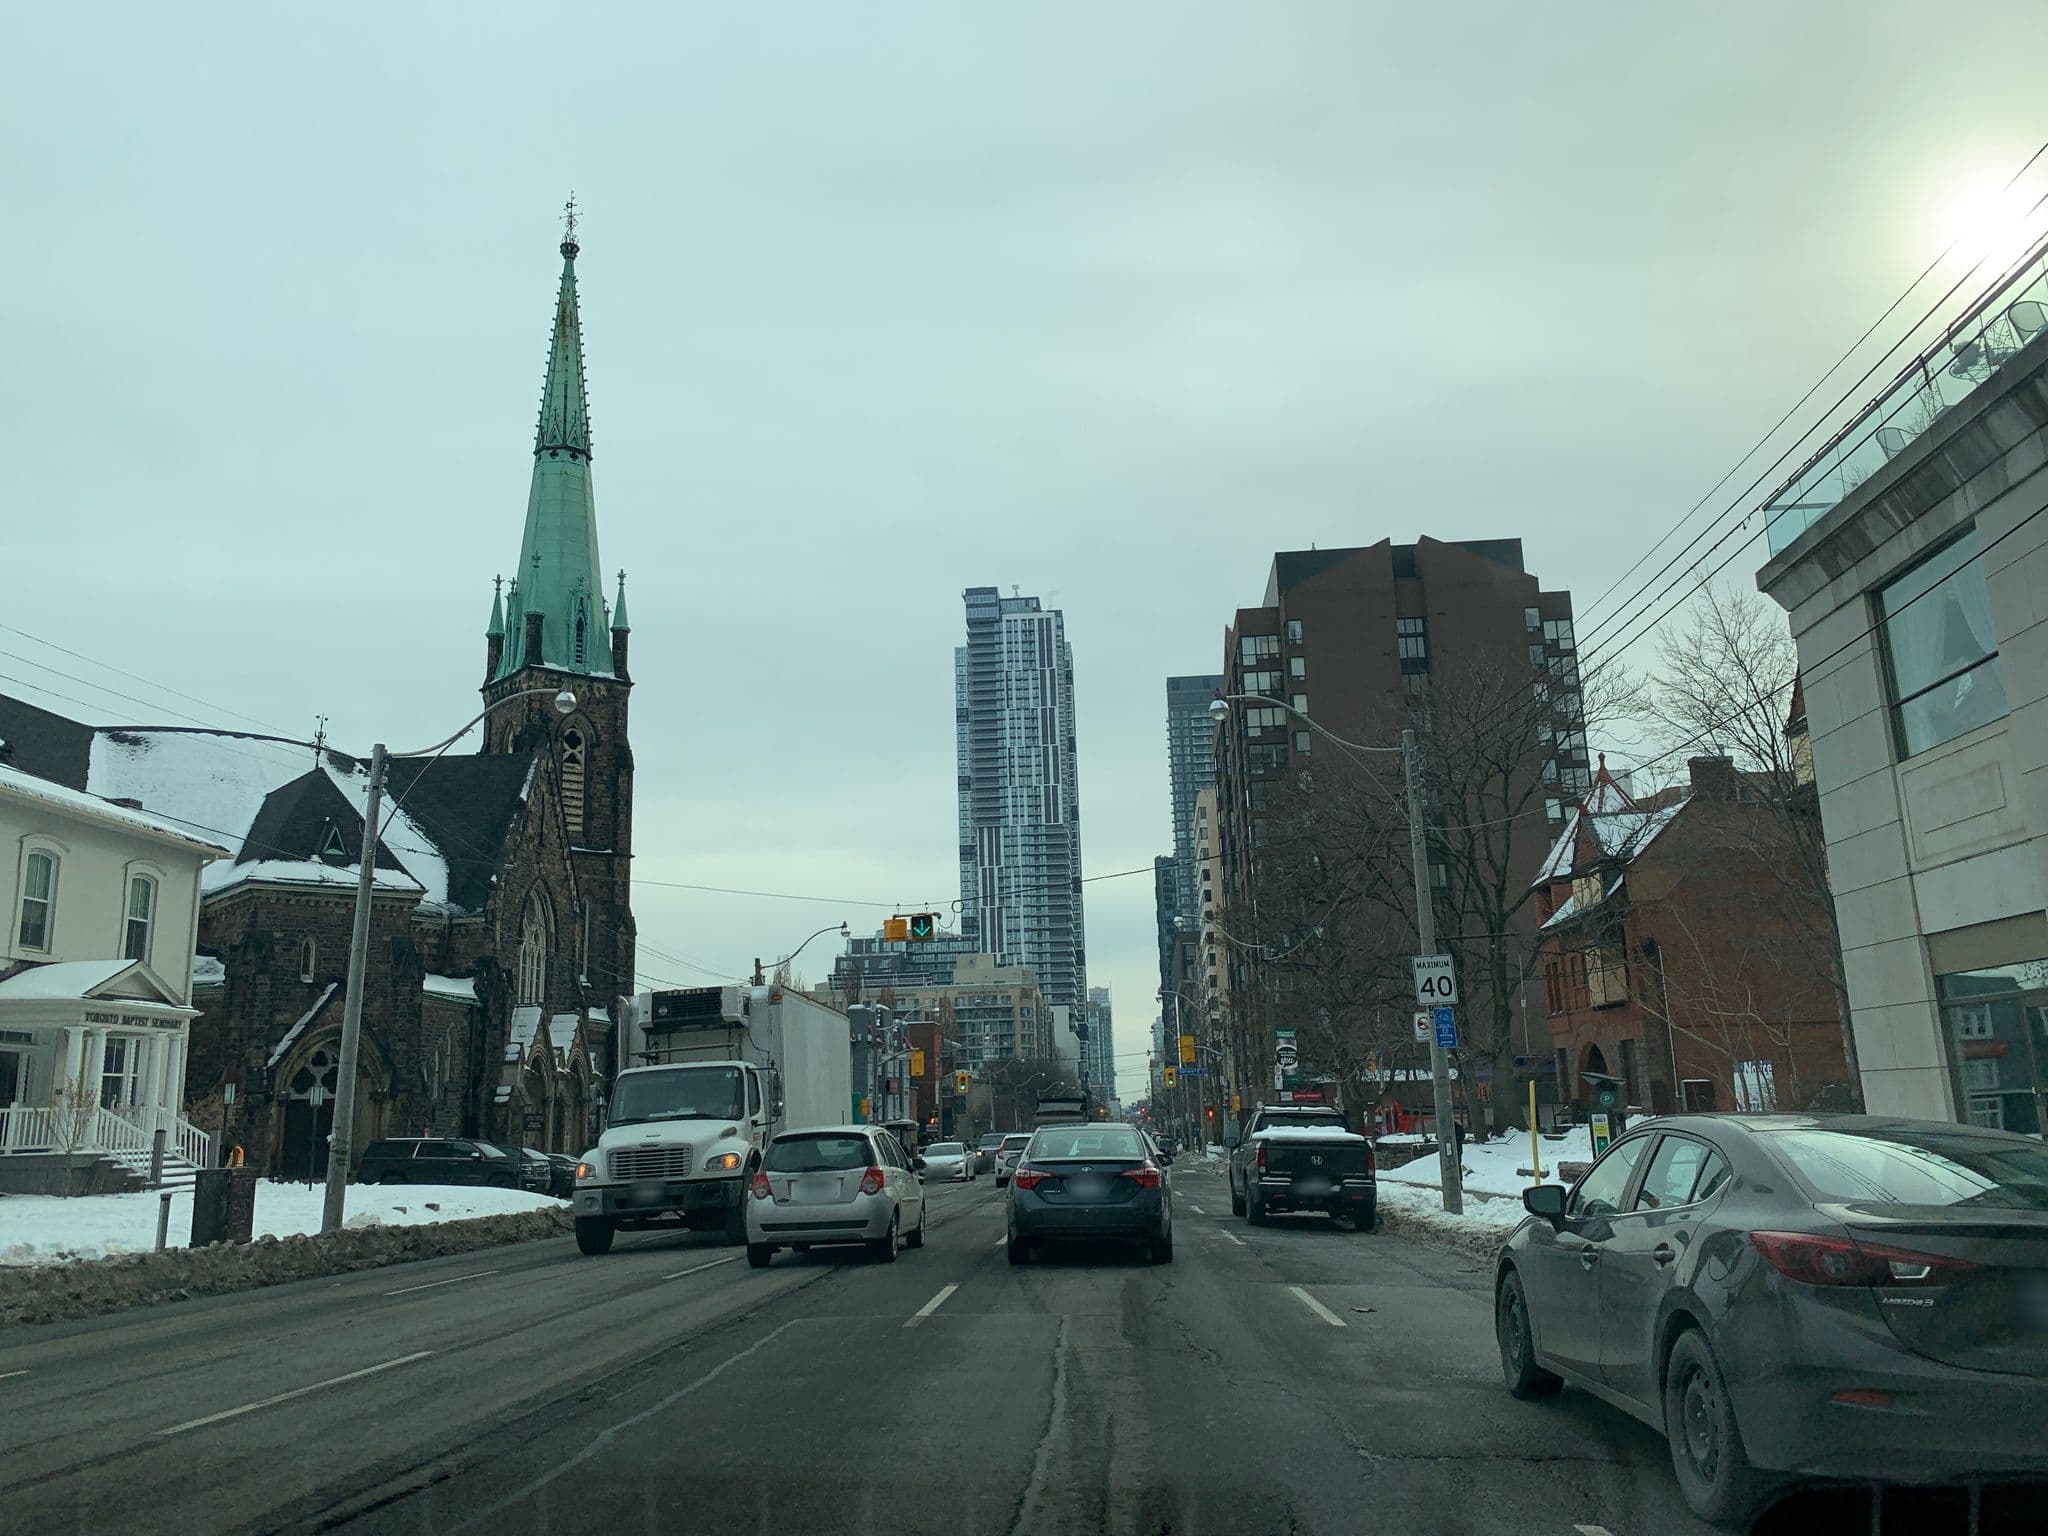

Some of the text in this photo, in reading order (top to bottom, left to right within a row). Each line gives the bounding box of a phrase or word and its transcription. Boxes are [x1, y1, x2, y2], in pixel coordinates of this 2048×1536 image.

[1416, 960, 1450, 970] MAXIMUM
[667, 988, 708, 996] CARRIER
[1420, 976, 1453, 998] 40
[84, 1012, 119, 1025] TORONTO
[122, 1015, 150, 1027] BAPTIST
[1743, 1060, 1773, 1074] Noice
